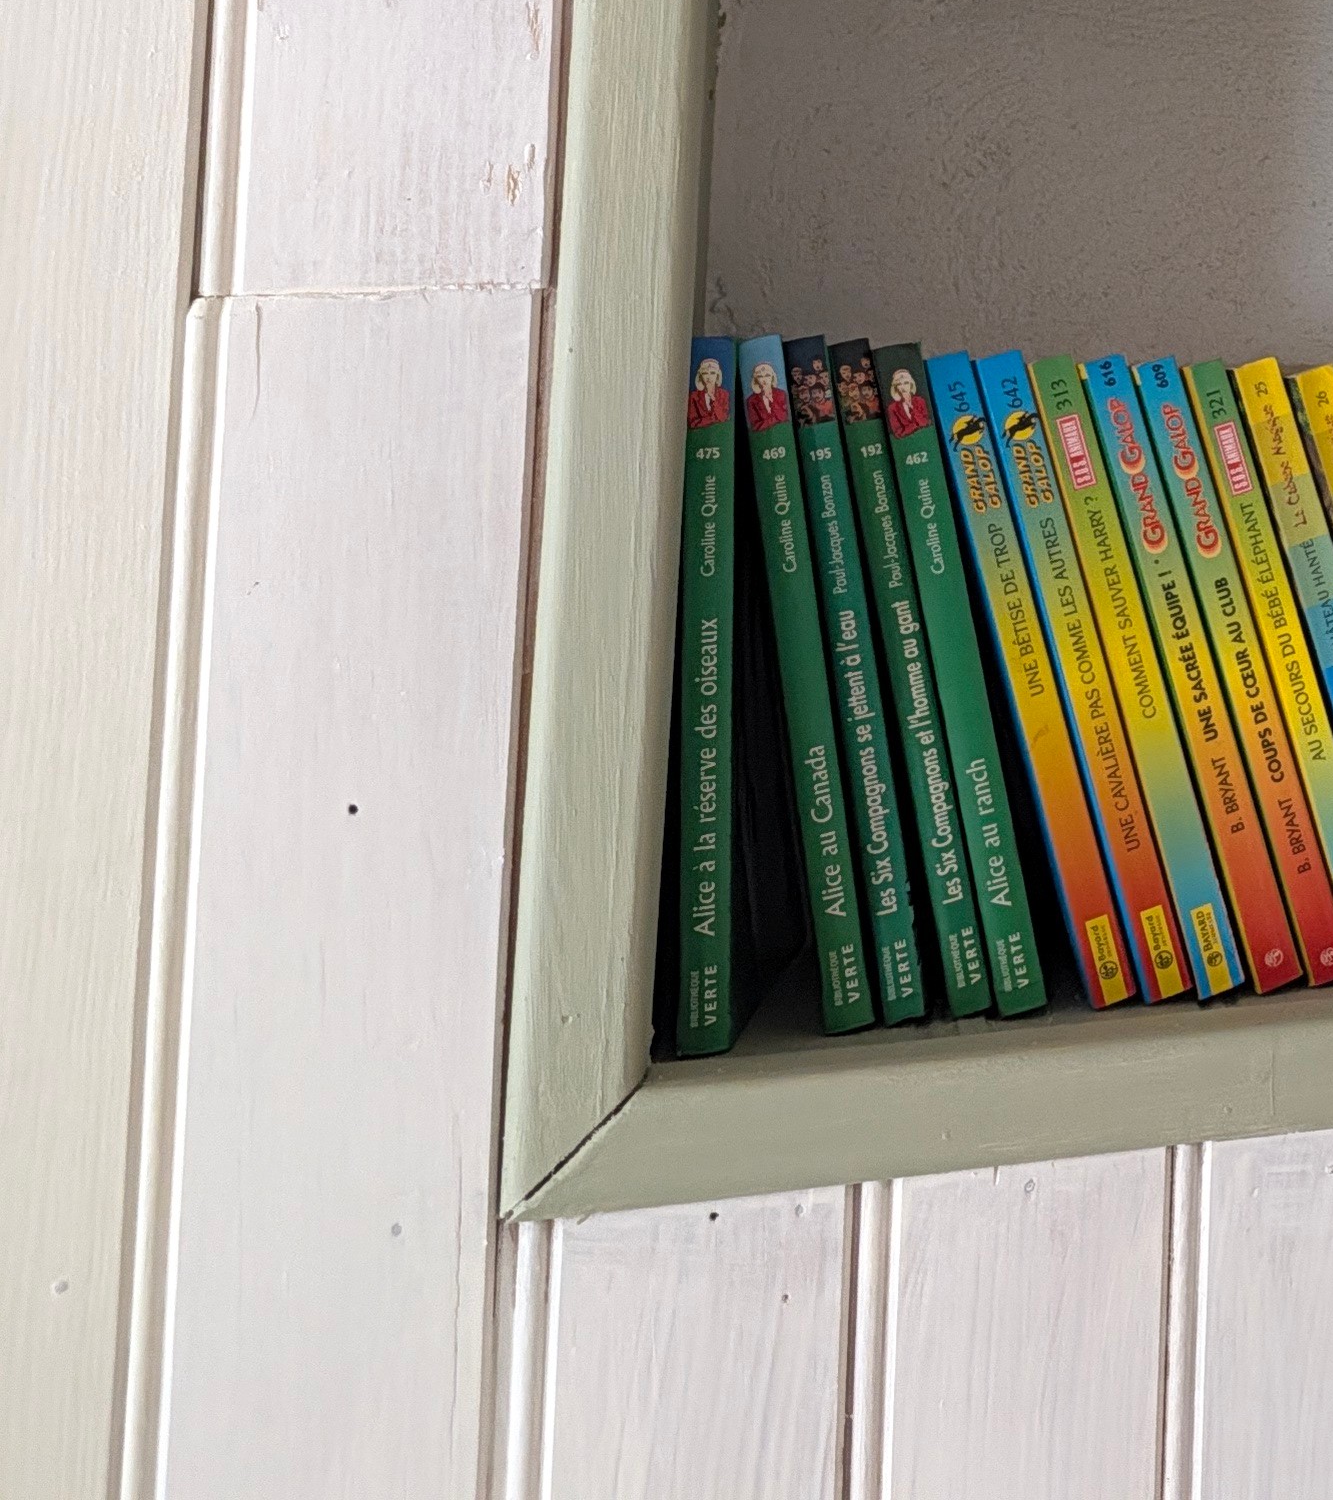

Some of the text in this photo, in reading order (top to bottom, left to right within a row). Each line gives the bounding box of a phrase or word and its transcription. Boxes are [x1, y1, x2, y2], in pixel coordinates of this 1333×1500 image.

[1000, 376, 1023, 408] 642
[1100, 360, 1116, 387] 616
[1151, 363, 1170, 388] 609
[948, 380, 970, 412] 645
[1051, 378, 1072, 410] 313
[1206, 389, 1227, 420] 321
[696, 447, 720, 460] 475
[762, 446, 786, 460] 469
[810, 448, 832, 462] 195
[860, 443, 882, 458] 192
[905, 451, 929, 466] 462
[1062, 420, 1084, 457] ANIMAUX
[700, 474, 718, 577] Caroline Quine
[773, 474, 797, 573] Caroline Quine
[918, 478, 945, 575] Caroline Quine
[988, 522, 1045, 697] UNE BÊTISE DE TROP
[1040, 517, 1140, 852] UNE CAVALIÈRE PAS COMME LES AUTRES
[804, 745, 846, 917] Alice au Canada
[966, 758, 1012, 907] Alice au ranch
[1092, 924, 1106, 962] Bayard
[1196, 910, 1214, 952] BAYARD
[842, 943, 860, 1004] VERTE
[894, 938, 914, 998] VERTE
[961, 926, 982, 985] VERTE
[1008, 931, 1030, 989] VERTE
[704, 964, 718, 1026] VERTE
